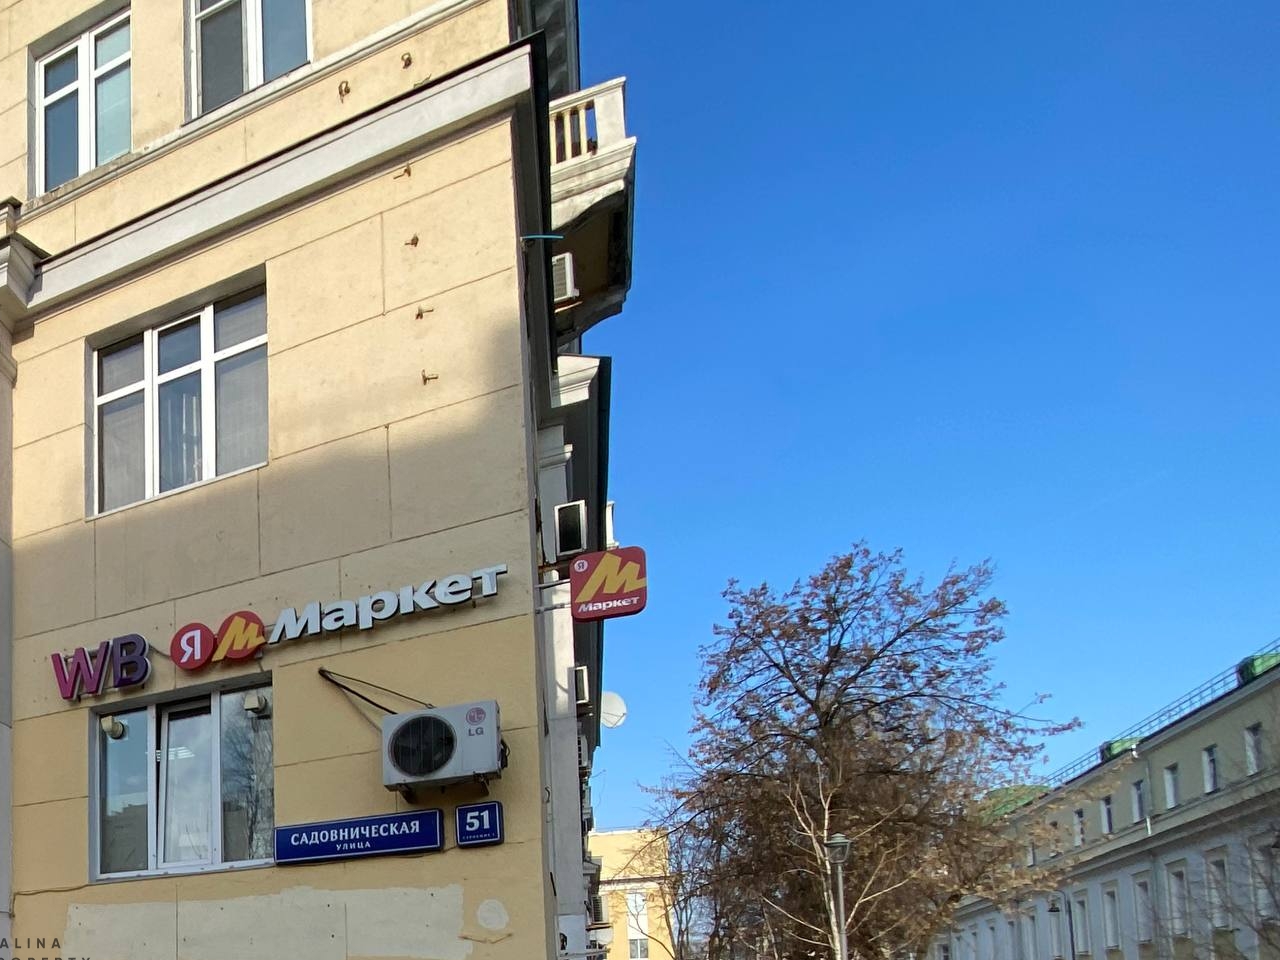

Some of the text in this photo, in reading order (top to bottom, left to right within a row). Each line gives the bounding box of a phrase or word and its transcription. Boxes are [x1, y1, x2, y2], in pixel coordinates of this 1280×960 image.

[179, 629, 201, 662] Я
[267, 564, 508, 645] Маркет
[578, 597, 640, 612] Маркет
[51, 633, 151, 700] WB
[468, 727, 484, 736] LG
[465, 810, 490, 832] 51
[290, 820, 420, 846] САДОВНИЧЕСКАЯ
[336, 842, 371, 852] УЛИЦА
